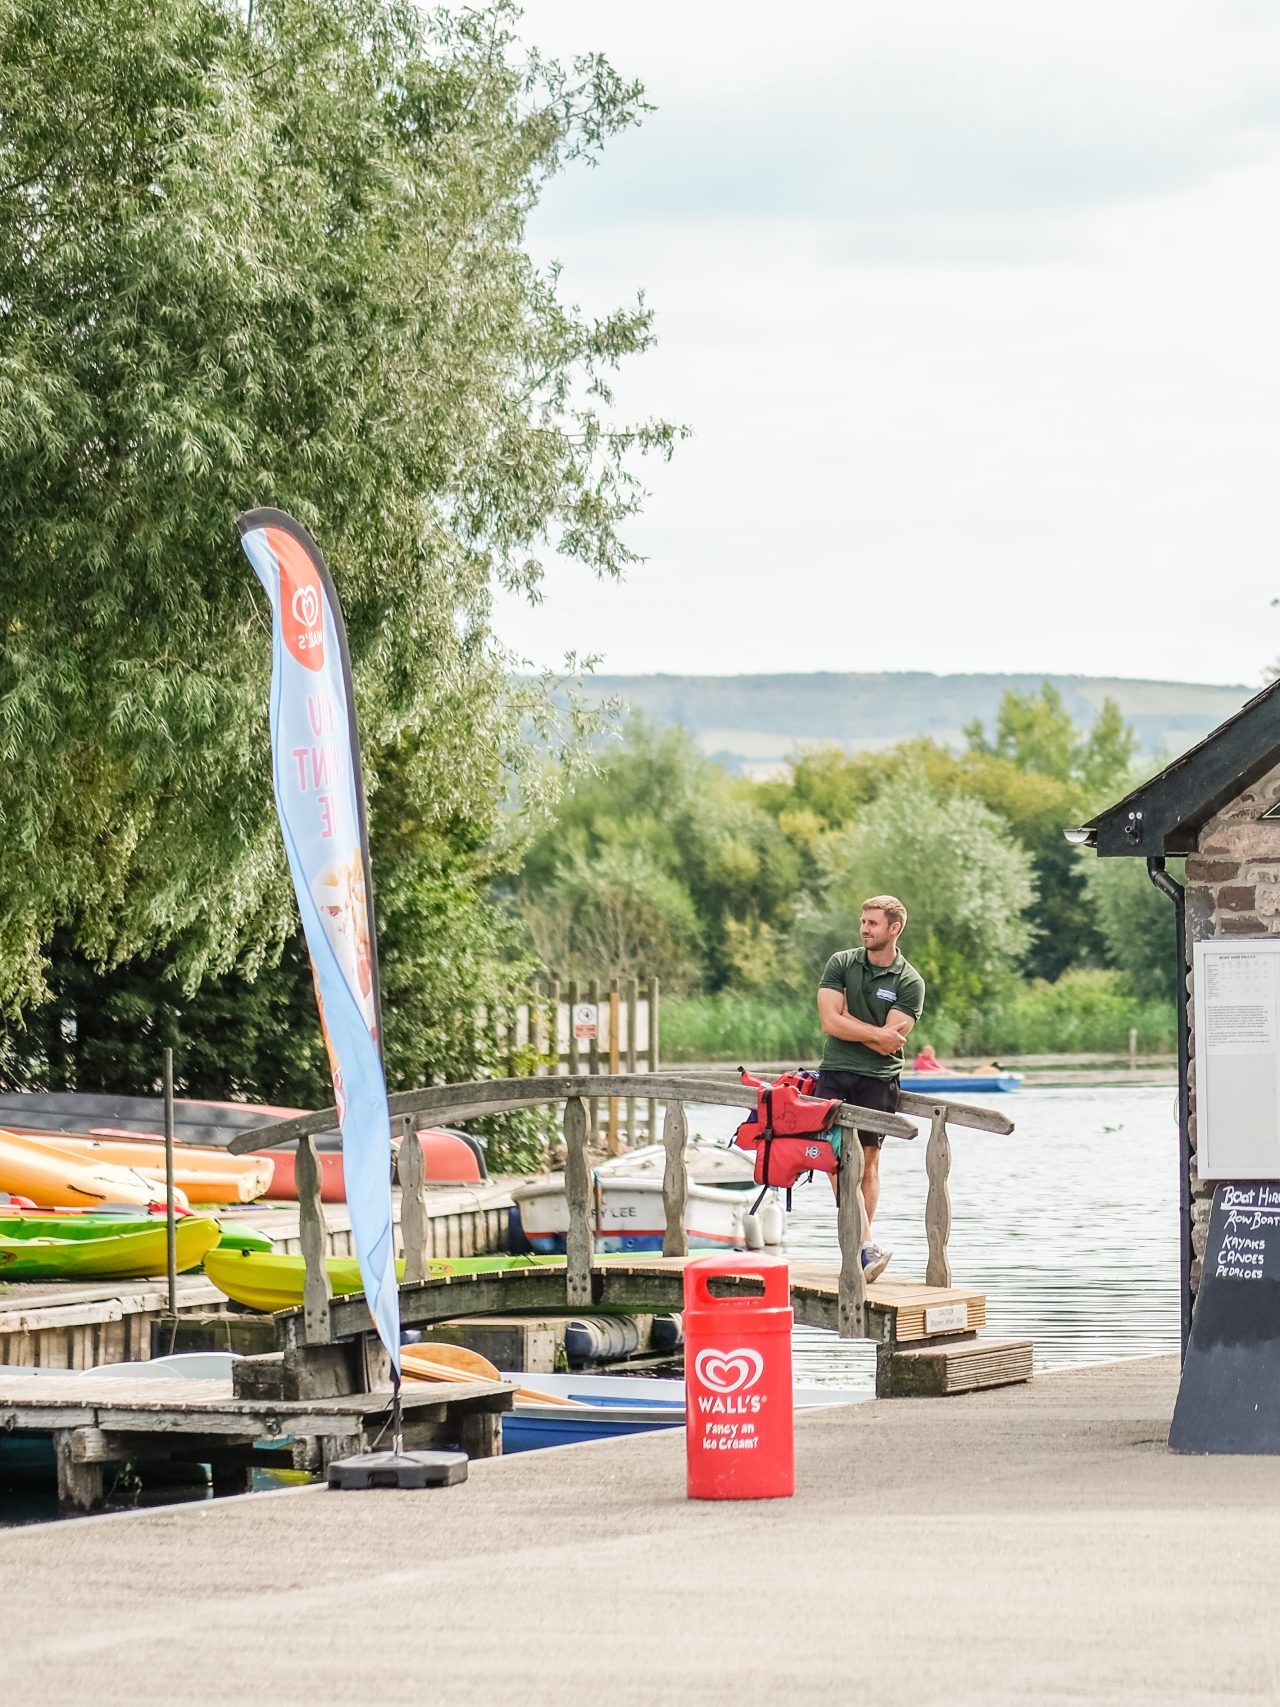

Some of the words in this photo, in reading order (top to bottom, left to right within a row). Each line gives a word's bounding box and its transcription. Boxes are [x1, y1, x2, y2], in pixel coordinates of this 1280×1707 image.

[612, 1206, 637, 1218] LEE
[1222, 1234, 1266, 1251] KAYAKS
[1217, 1250, 1264, 1265] CANOES
[1216, 1265, 1263, 1279] PEDALOES
[698, 1395, 763, 1414] WALL'S
[705, 1422, 739, 1437] Fancy
[740, 1422, 755, 1434] an
[702, 1437, 717, 1450] Ice
[719, 1436, 759, 1450] Cream?
